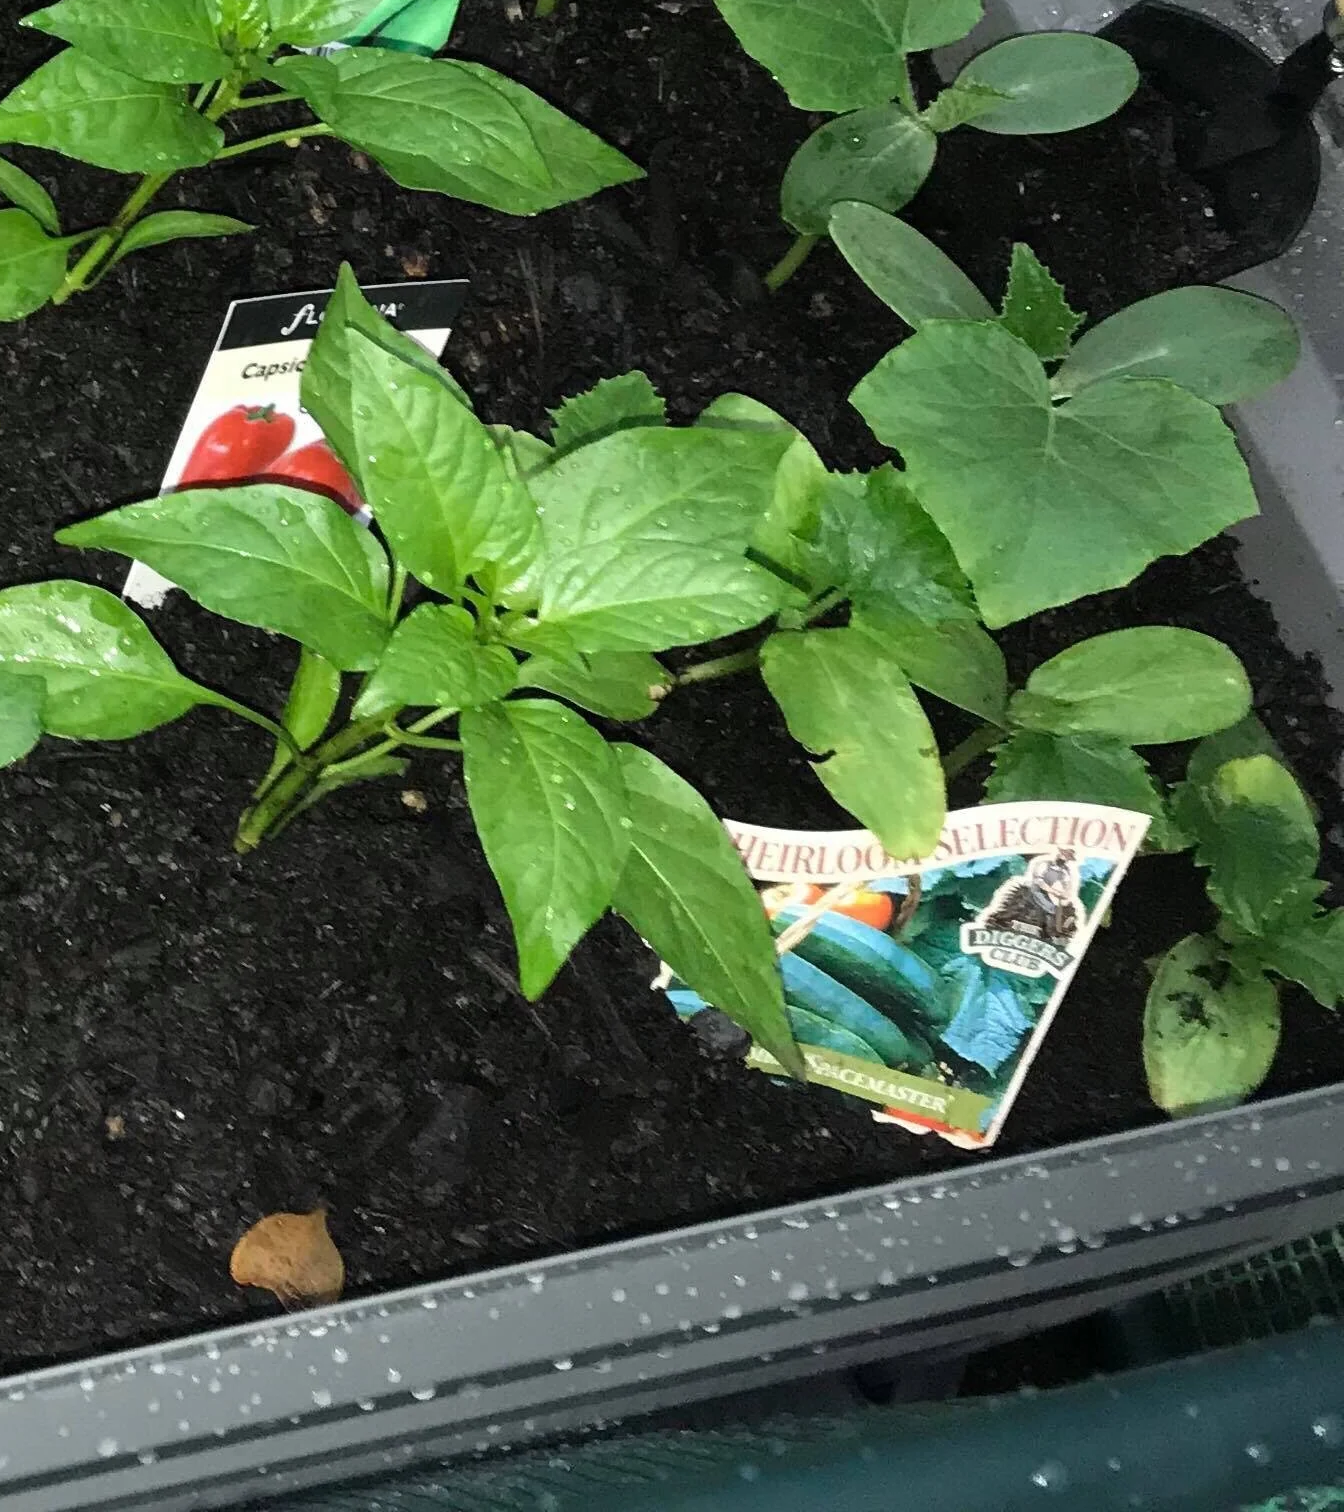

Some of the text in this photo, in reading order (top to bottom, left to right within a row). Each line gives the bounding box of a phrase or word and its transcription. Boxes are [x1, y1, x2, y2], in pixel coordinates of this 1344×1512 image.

[241, 356, 307, 381] Capsic
[938, 816, 1137, 859] SELECTION
[974, 930, 1069, 967] DIGGERS
